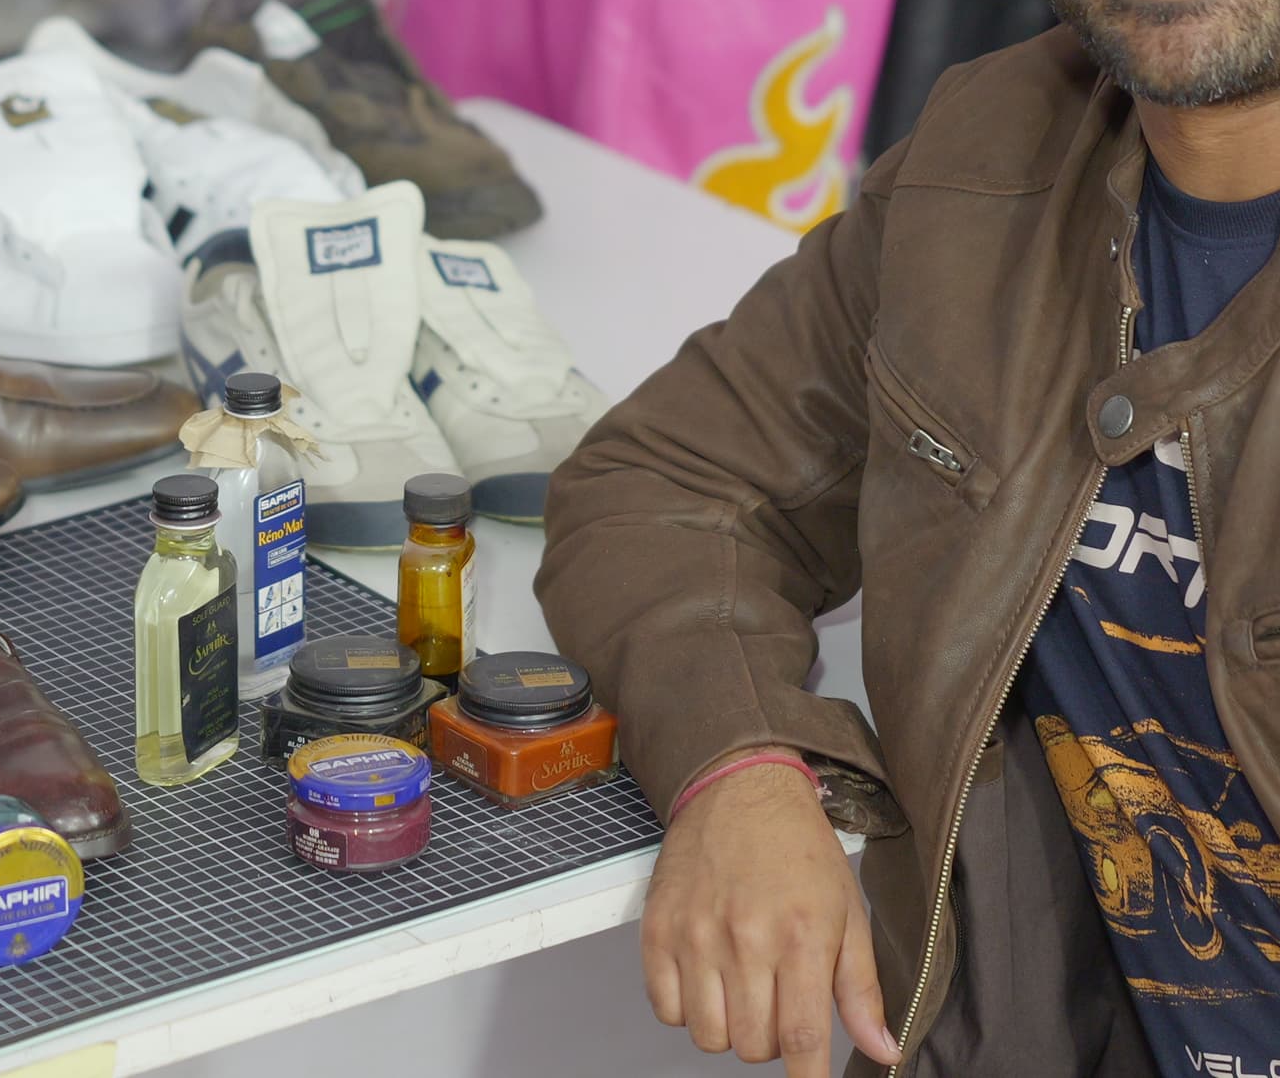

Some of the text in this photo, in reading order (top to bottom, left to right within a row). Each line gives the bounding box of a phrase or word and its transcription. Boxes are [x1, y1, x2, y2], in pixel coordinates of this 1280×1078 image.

[261, 487, 300, 510] SAPHIR
[208, 595, 231, 615] GUARD
[311, 751, 402, 773] SAPHIR
[309, 827, 320, 838] 08
